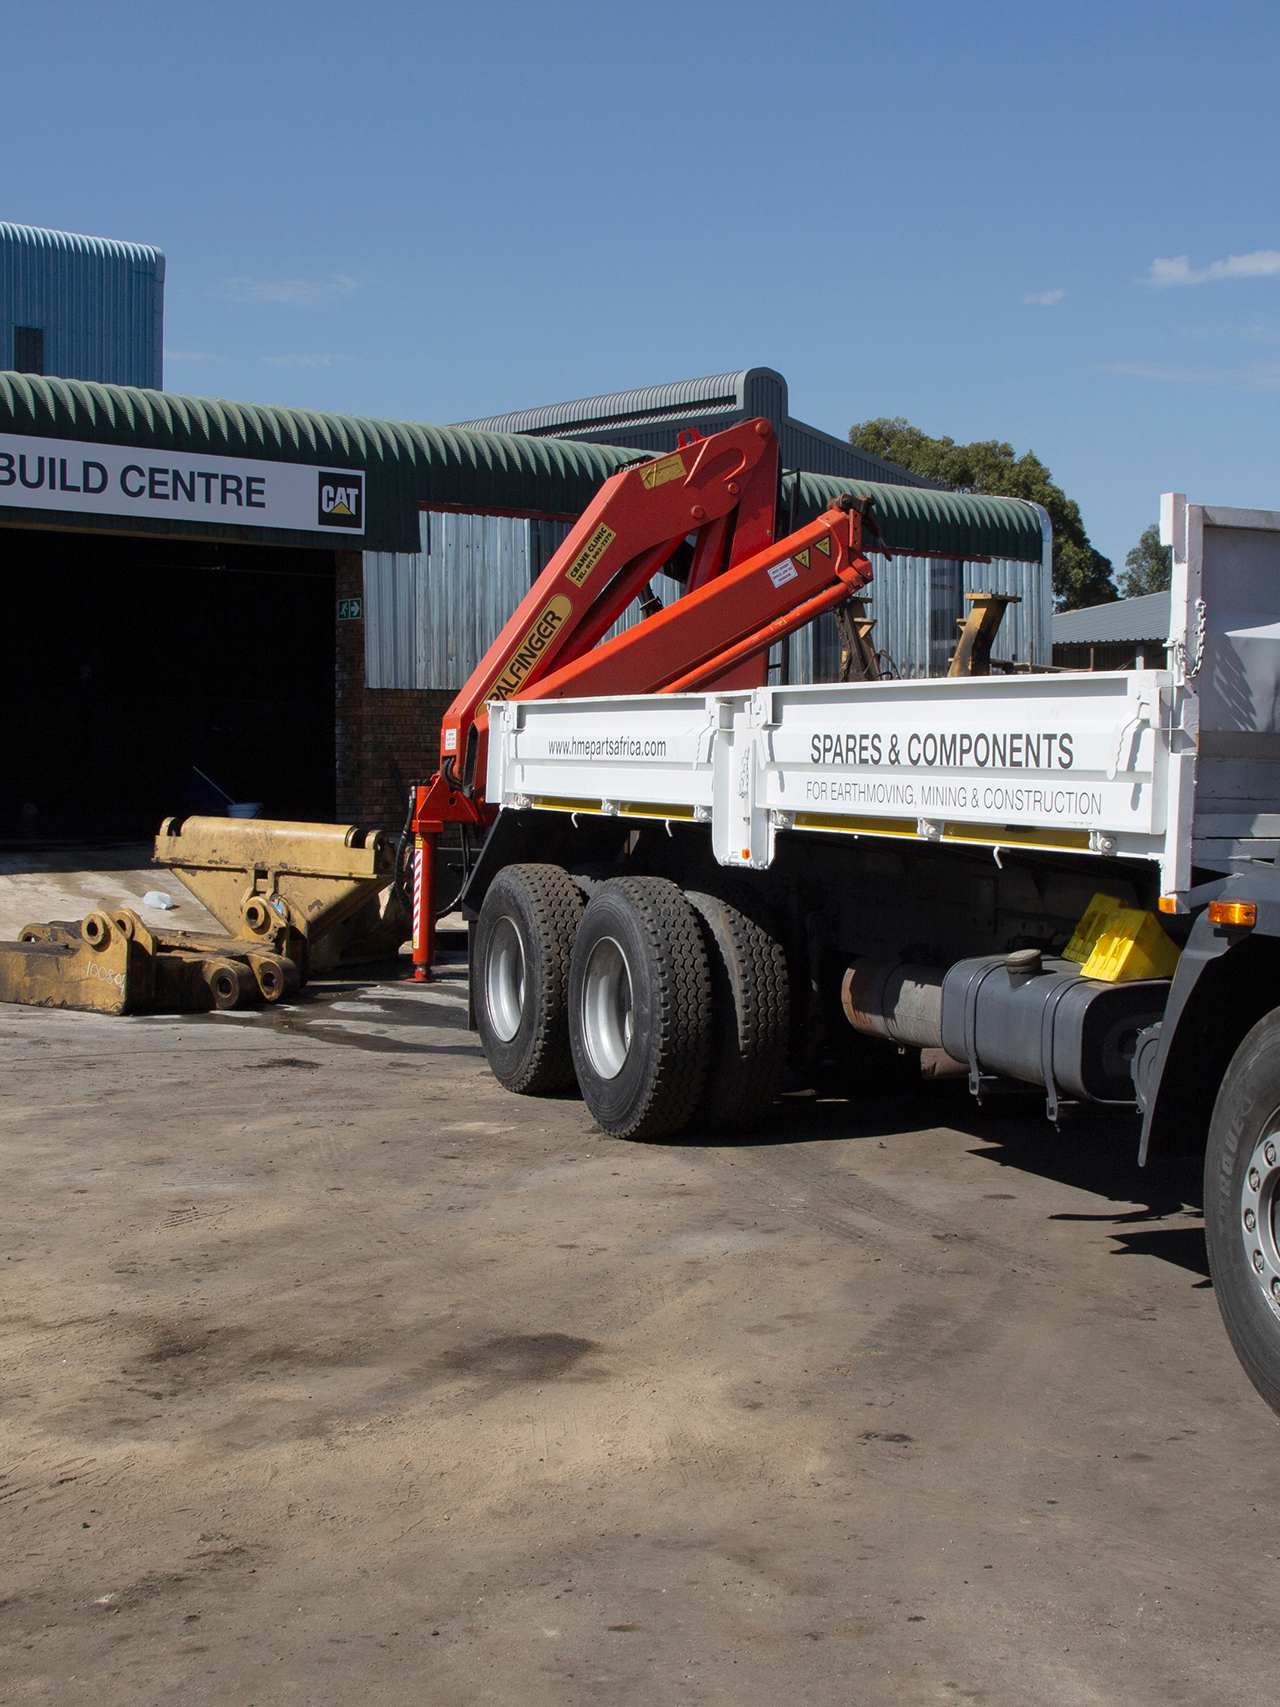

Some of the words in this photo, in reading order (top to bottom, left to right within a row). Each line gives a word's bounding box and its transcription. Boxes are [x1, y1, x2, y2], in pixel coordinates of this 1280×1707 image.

[120, 464, 266, 508] CENTRE
[322, 485, 359, 516] CAT
[570, 552, 590, 578] CRANE
[588, 527, 607, 552] CLINIC
[548, 735, 667, 760] www.hmepartsafrica.com
[810, 733, 882, 765] SPARES
[889, 733, 901, 765] &
[907, 733, 1074, 769] COMPONENTS
[806, 781, 828, 800] FOR
[831, 782, 917, 809] EARTHMOVING,
[921, 786, 966, 808] MINING
[972, 788, 980, 809] &
[984, 788, 1102, 815] CONSTRUCTION
